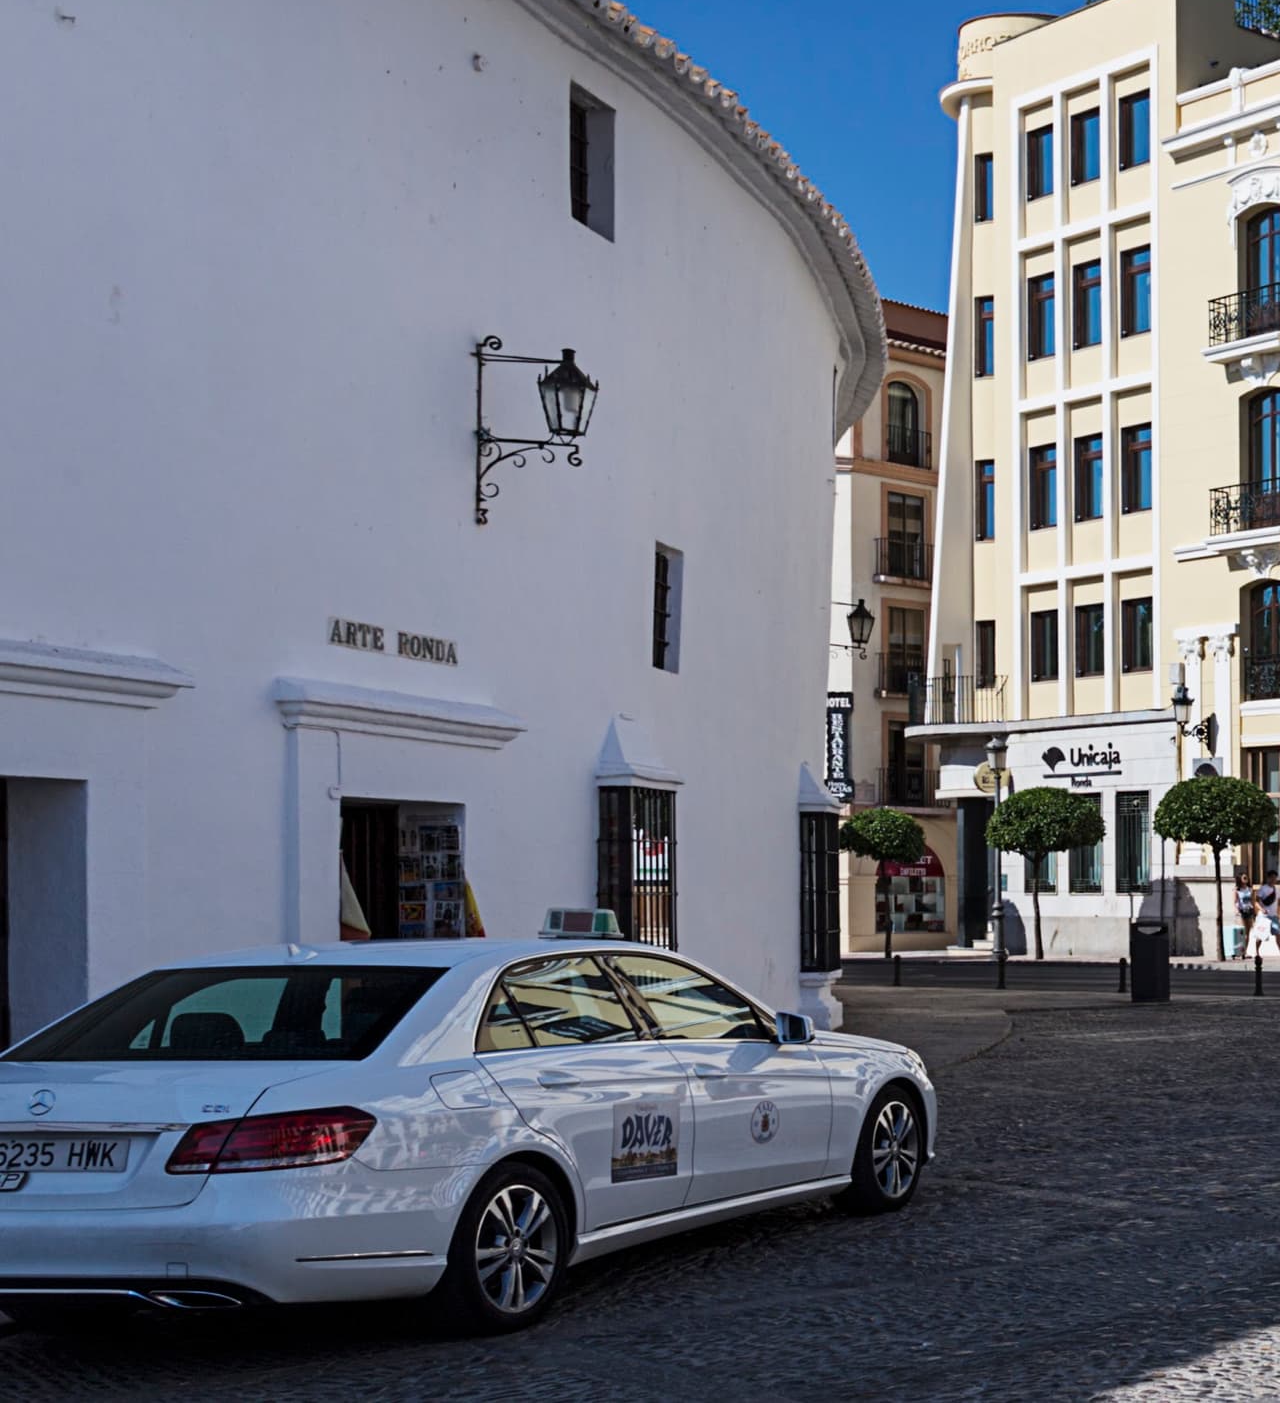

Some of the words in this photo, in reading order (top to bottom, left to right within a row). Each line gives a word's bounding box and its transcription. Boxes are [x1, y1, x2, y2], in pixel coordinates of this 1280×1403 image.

[330, 619, 385, 651] ARTE
[397, 630, 458, 665] RONDA
[1070, 742, 1121, 770] Unicaja
[621, 1113, 673, 1149] DAVER
[67, 1140, 118, 1170] HWK
